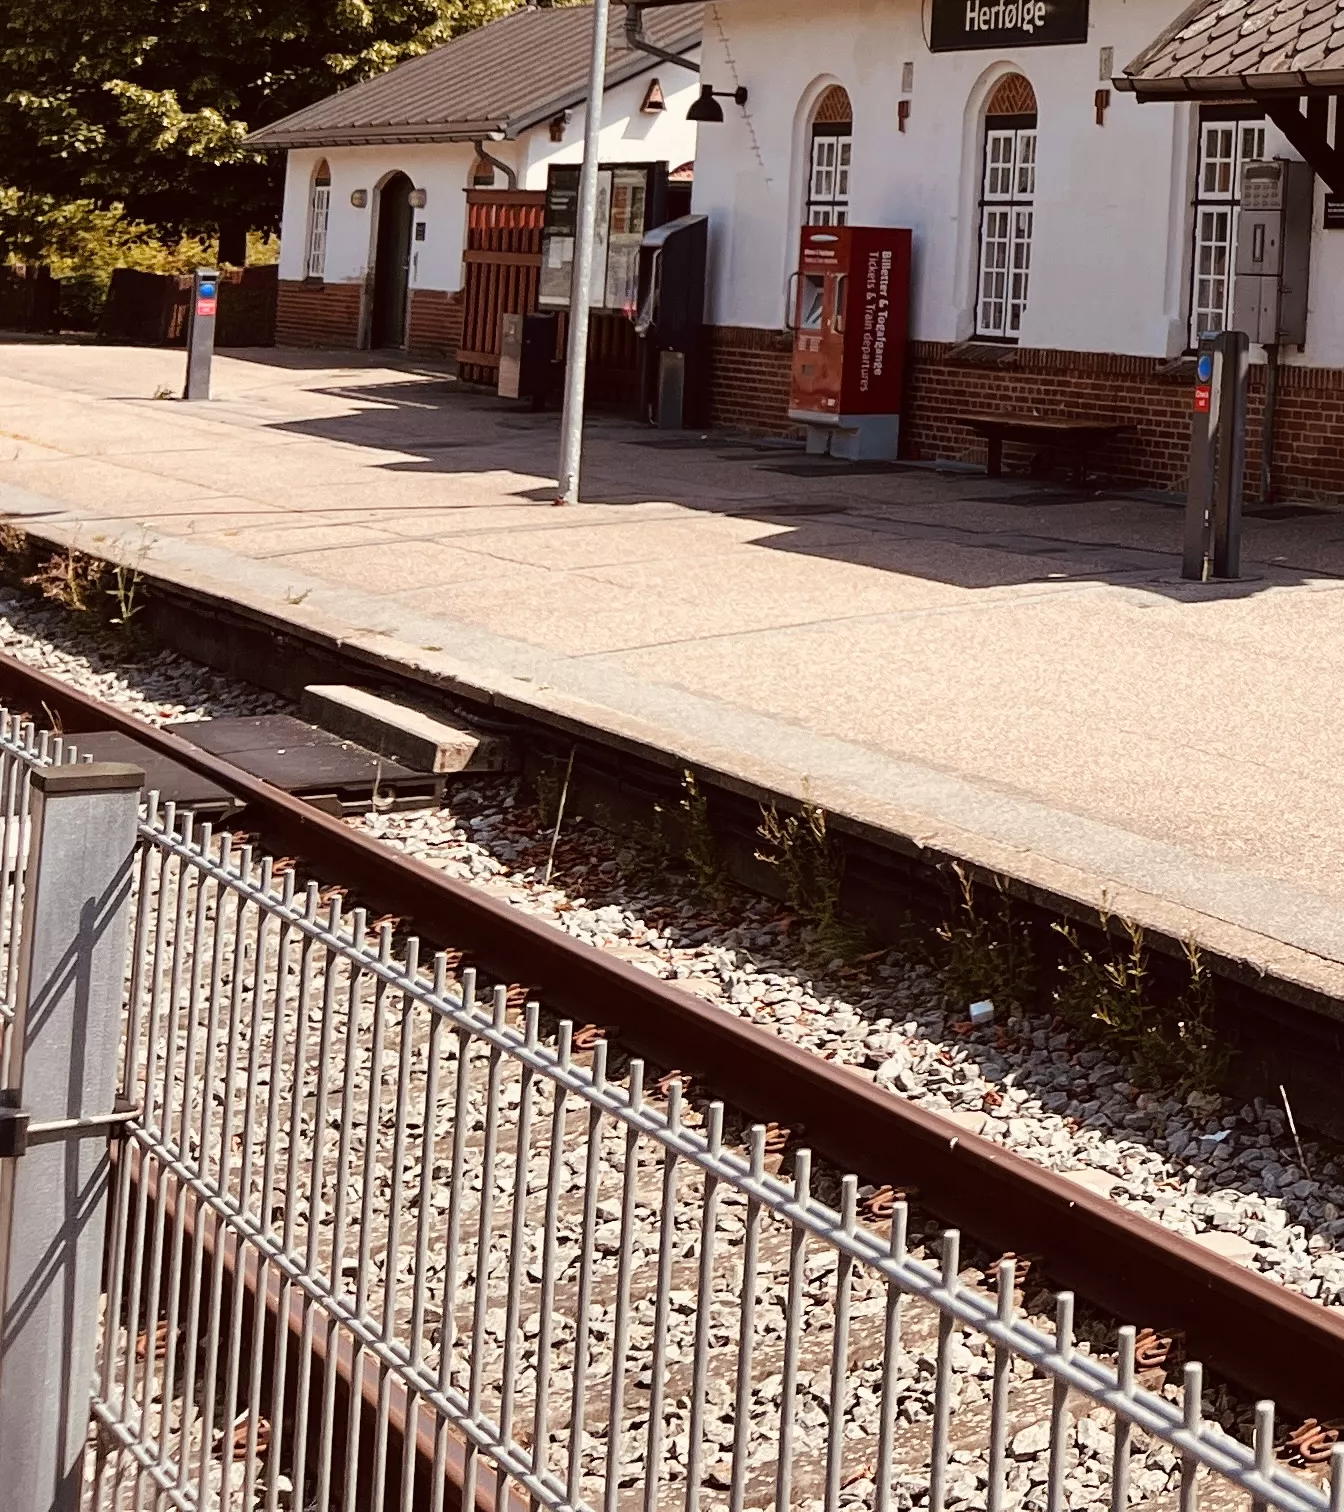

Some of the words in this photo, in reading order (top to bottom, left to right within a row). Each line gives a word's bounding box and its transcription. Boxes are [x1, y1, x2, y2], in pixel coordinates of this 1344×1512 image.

[866, 251, 880, 289] Tickets
[879, 250, 892, 297] Billetter
[866, 292, 877, 300] &
[878, 299, 889, 308] &
[863, 303, 877, 330] Train
[860, 332, 874, 392] departures
[873, 310, 889, 376] Togafgange
